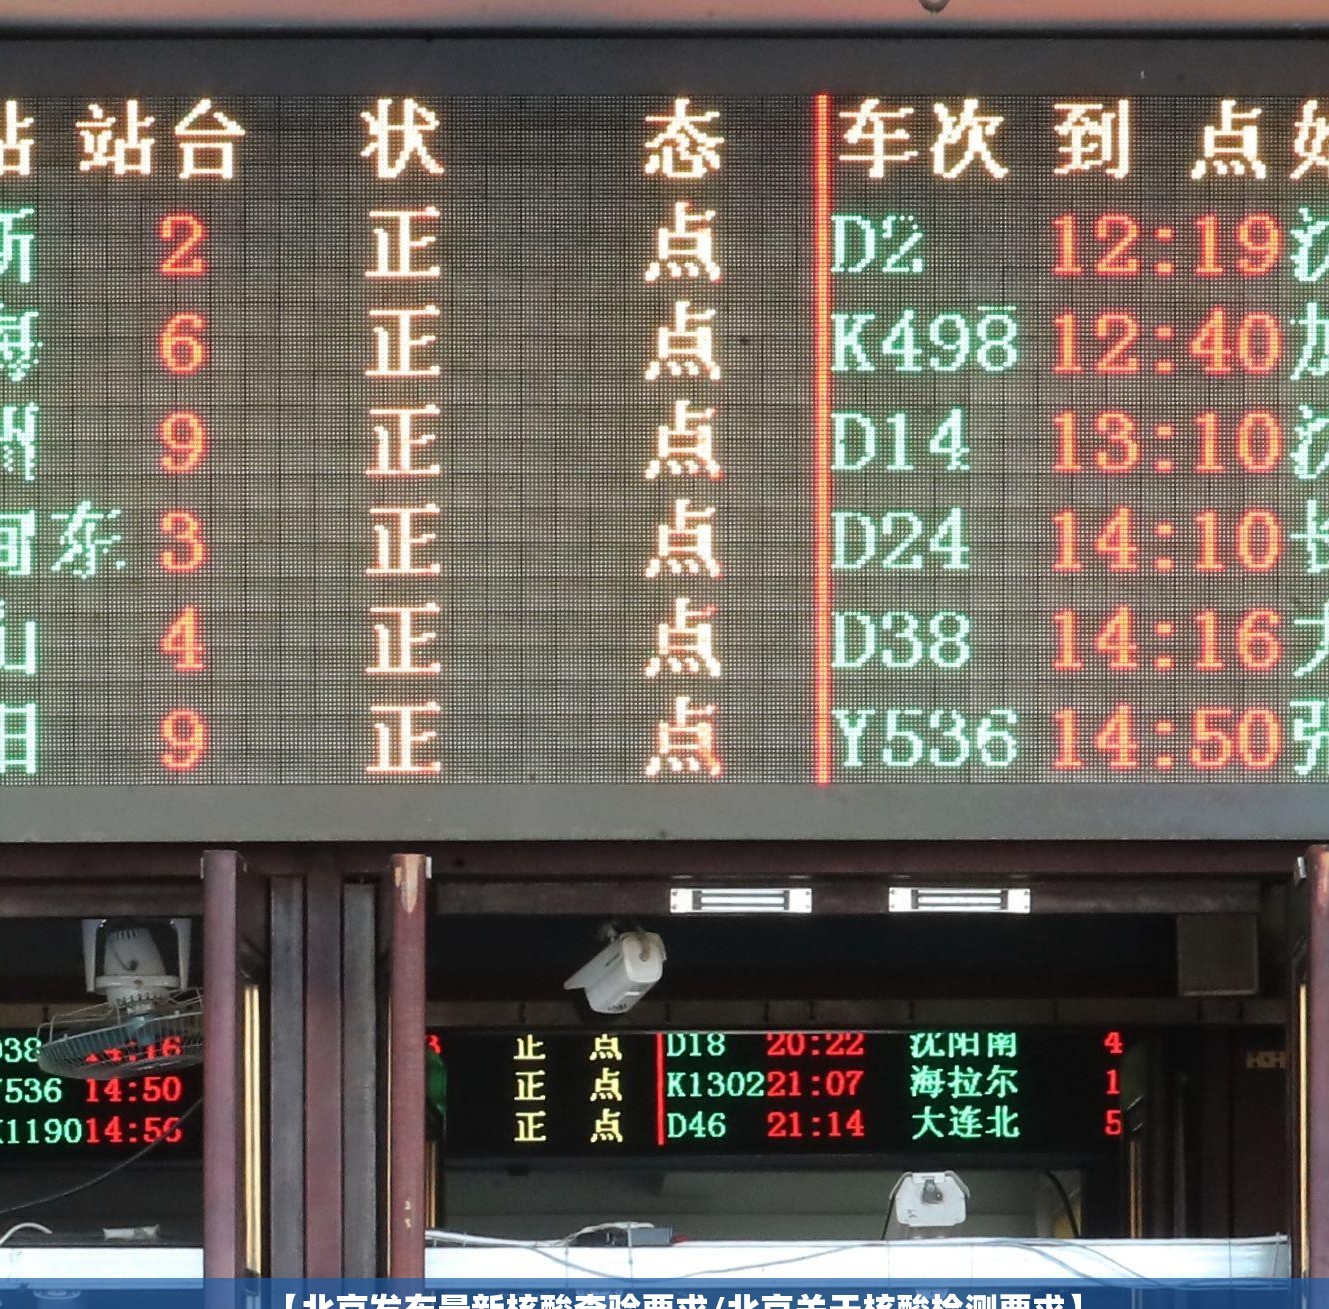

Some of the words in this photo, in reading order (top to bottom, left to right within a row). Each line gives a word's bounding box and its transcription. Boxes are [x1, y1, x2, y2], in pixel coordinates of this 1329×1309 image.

[78, 101, 246, 179] 站台
[841, 101, 1008, 179] 车次
[161, 215, 206, 277] 2
[833, 217, 923, 273] D2
[1056, 215, 1282, 277] 12:19
[161, 313, 206, 375] 6
[833, 311, 1018, 372] K498
[1056, 309, 1282, 375] 12:40
[161, 412, 207, 474] 9
[833, 410, 970, 471] D14
[1057, 411, 1283, 474] 13:10
[161, 511, 207, 574] 3
[833, 509, 970, 569] D24
[1055, 509, 1282, 573] 14:10
[162, 609, 203, 672] 4
[833, 613, 971, 668] D38
[1056, 608, 1282, 672] 14:16
[162, 710, 208, 772] 9
[833, 708, 1018, 767] Y536
[1057, 707, 1282, 770] 14:50
[669, 1034, 726, 1057] D18
[768, 1032, 865, 1056] 20:22
[912, 1034, 1017, 1059] 沈阳南
[1106, 1032, 1123, 1054] 4
[88, 1077, 183, 1103] 14:50
[669, 1073, 765, 1098] K1302
[769, 1072, 864, 1097] 21:07
[912, 1066, 1018, 1099] 海拉尔
[1109, 1071, 1119, 1095] 1
[88, 1117, 183, 1144] 14:56
[670, 1112, 726, 1138] D46
[769, 1111, 864, 1138] 21:14
[914, 1107, 1020, 1139] 大连北
[1106, 1111, 1122, 1135] 5
